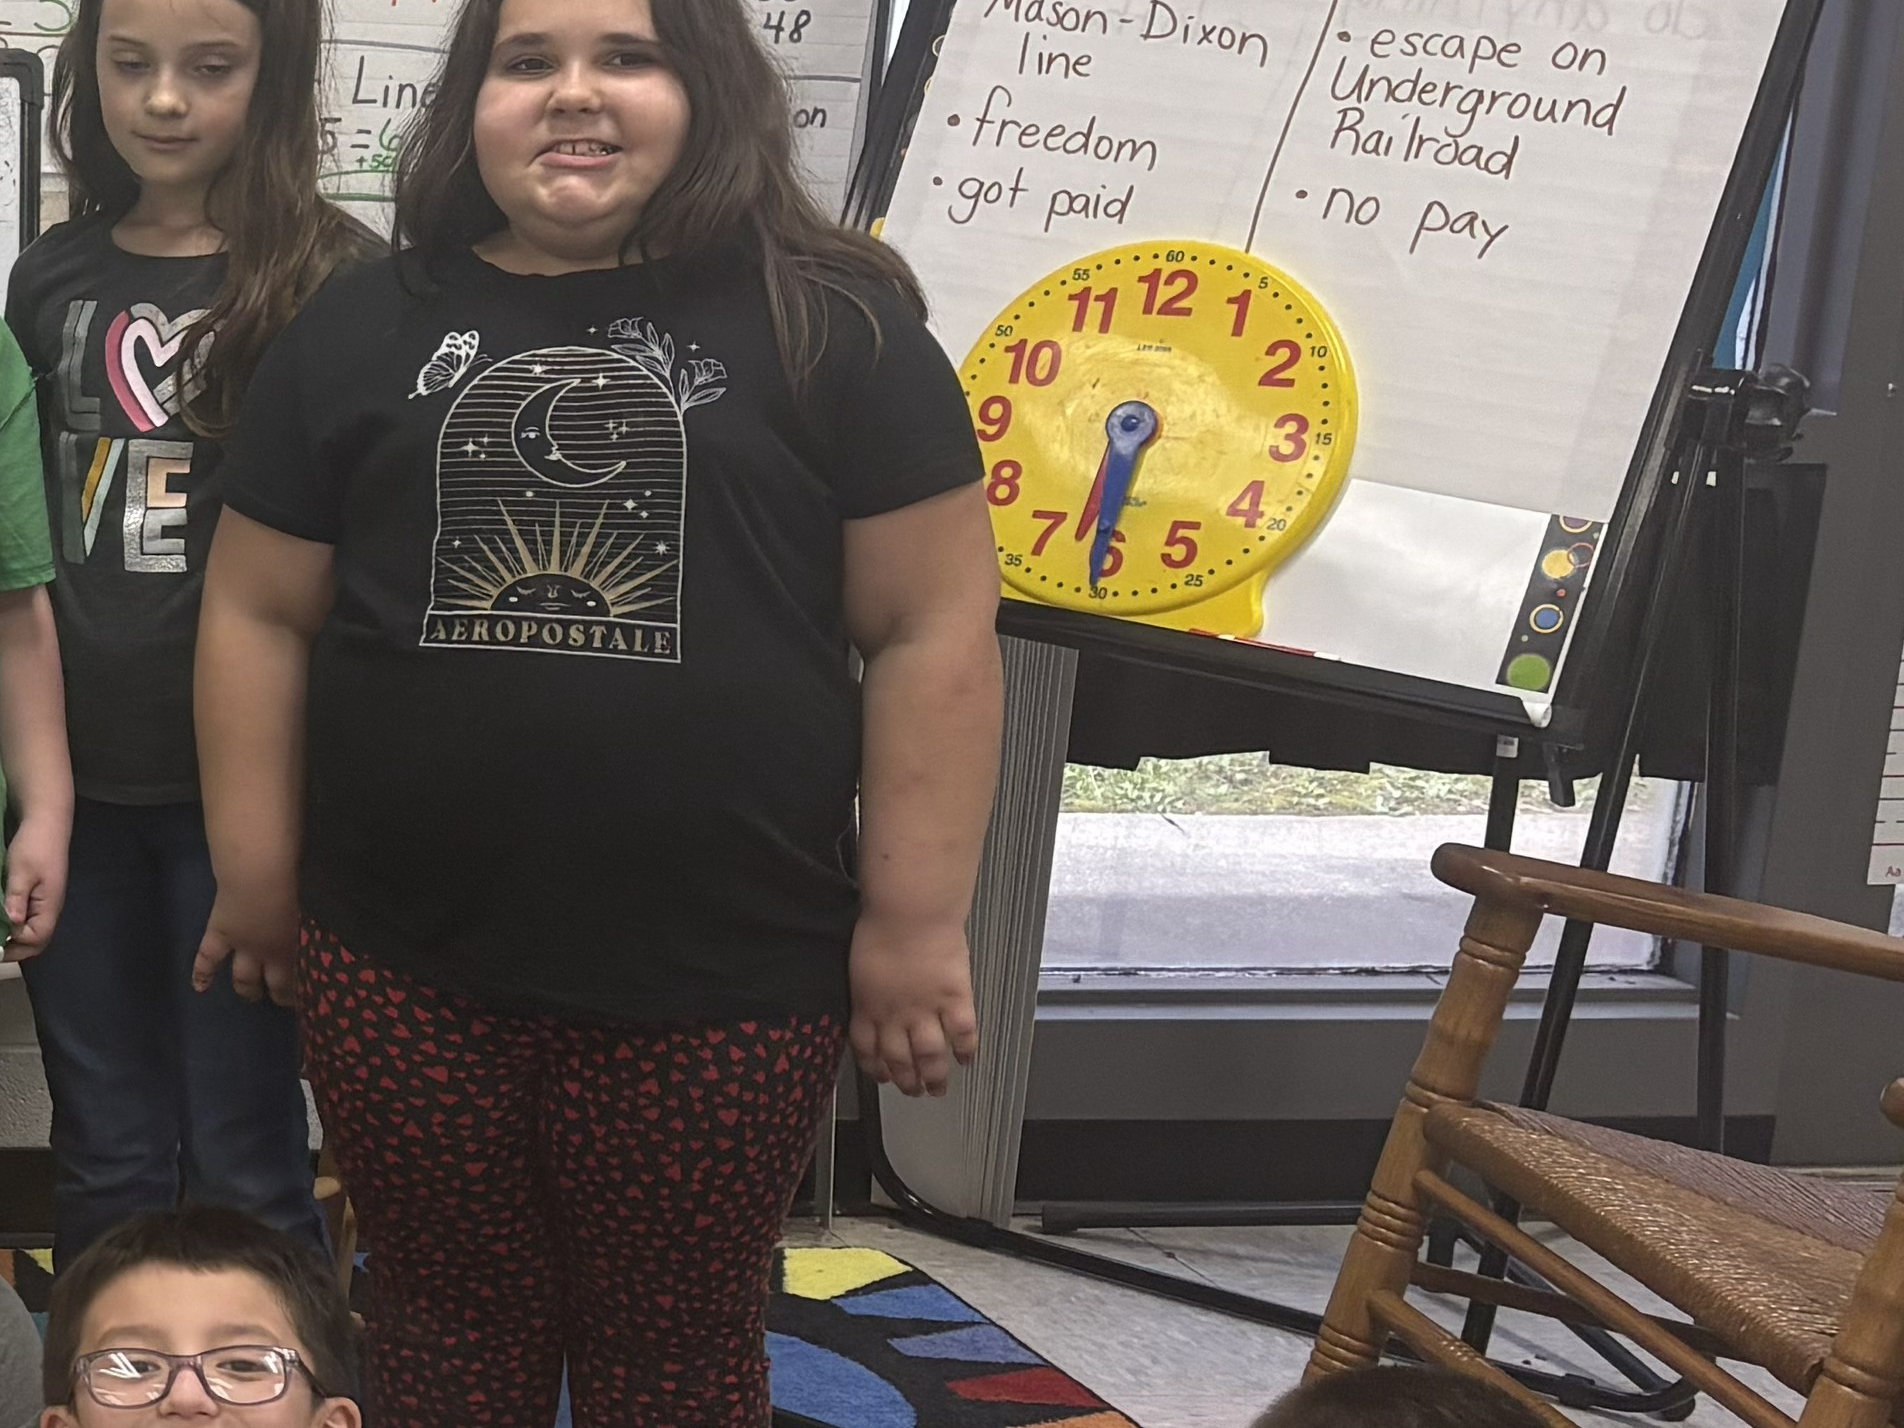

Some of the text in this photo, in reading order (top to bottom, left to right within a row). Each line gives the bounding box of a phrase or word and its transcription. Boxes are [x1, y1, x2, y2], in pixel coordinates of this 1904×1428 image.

[763, 9, 811, 44] 48
[1017, 33, 1092, 80] line
[1369, 28, 1607, 76] escape on
[1330, 58, 1626, 137] Underground
[973, 84, 1158, 171] freedom
[1332, 108, 1521, 179] Railroad
[957, 169, 1134, 233] got paid
[1322, 185, 1511, 247] no pay
[1072, 268, 1091, 281] 55
[1166, 250, 1185, 264] 60
[1138, 269, 1199, 316] 12
[1259, 276, 1269, 290] 5
[995, 324, 1013, 337] 50
[1068, 287, 1118, 334] 11
[1226, 289, 1252, 337] 1
[1003, 339, 1062, 387] 10
[1258, 340, 1302, 388] 2
[1309, 345, 1328, 358] 10
[977, 396, 1013, 442] 9
[1268, 413, 1309, 463] 3
[1315, 432, 1333, 445] 15
[986, 460, 1022, 506] 8
[1226, 480, 1266, 529] 4
[1030, 511, 1067, 557] 7
[1160, 521, 1201, 569] 5
[1267, 518, 1287, 531] 20
[1005, 553, 1023, 567] 35
[1184, 573, 1204, 588] 25
[429, 617, 673, 656] AEROPOSTALE
